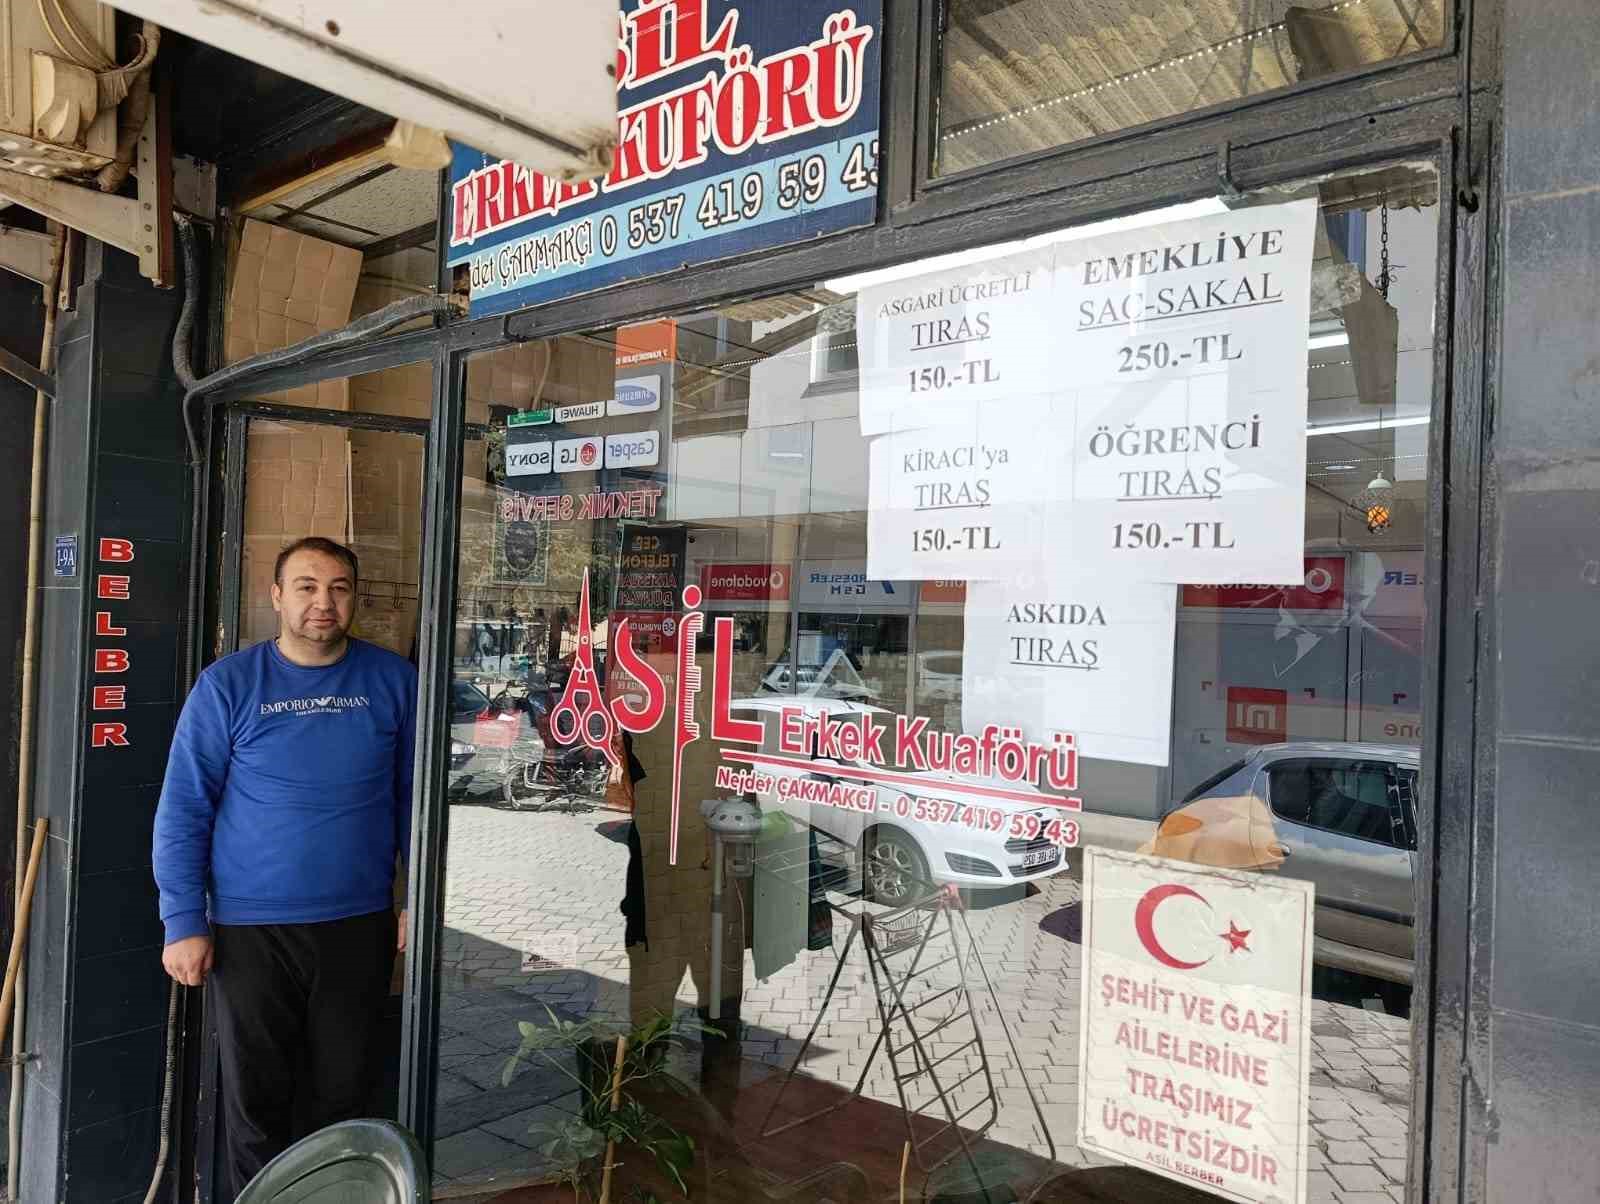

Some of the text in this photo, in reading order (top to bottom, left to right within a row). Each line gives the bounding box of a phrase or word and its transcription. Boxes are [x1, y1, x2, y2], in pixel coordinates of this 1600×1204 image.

[604, 11, 871, 191] KUFÖRÜ
[471, 256, 495, 289] det
[499, 219, 593, 287] ÇAKMAKÇI
[600, 214, 618, 256] 0
[628, 193, 686, 248] 537
[696, 174, 762, 229] 419
[777, 161, 827, 207] 59
[1082, 229, 1284, 286] EMEKLİYE
[879, 270, 1032, 319] ASGARİ ÜCRETLİ
[911, 311, 991, 348] TIRAŞ
[1117, 333, 1243, 373] 250.-TL
[908, 359, 1001, 393] 150.-TL
[1088, 414, 1263, 458] ÖĞRENCİ
[913, 479, 992, 508] TIRAŞ
[1118, 466, 1222, 500] TIRAŞ
[911, 525, 1002, 553] 150.-TL
[1112, 521, 1236, 550] 150.-TL
[1006, 603, 1107, 626] ASKIDA
[91, 537, 134, 748] BELBER
[1009, 636, 1099, 671] TIRAŞ
[260, 699, 315, 715] EMPORIO
[779, 705, 1079, 790] Erkek Kuaförü
[716, 766, 775, 796] Nejdet
[895, 796, 911, 818] 0
[914, 799, 955, 824] 537
[960, 805, 1003, 832] 419
[1008, 813, 1042, 841] 59
[1043, 818, 1080, 847] 43
[1101, 973, 1290, 1045] ŞEHİT VE GAZİ
[1115, 1019, 1270, 1087] AİLELERİNE
[1127, 1066, 1253, 1129] TRAŞIMIZ
[1102, 1097, 1279, 1186] ÜCRETSİZDİR
[1175, 1161, 1224, 1186] BERBER
